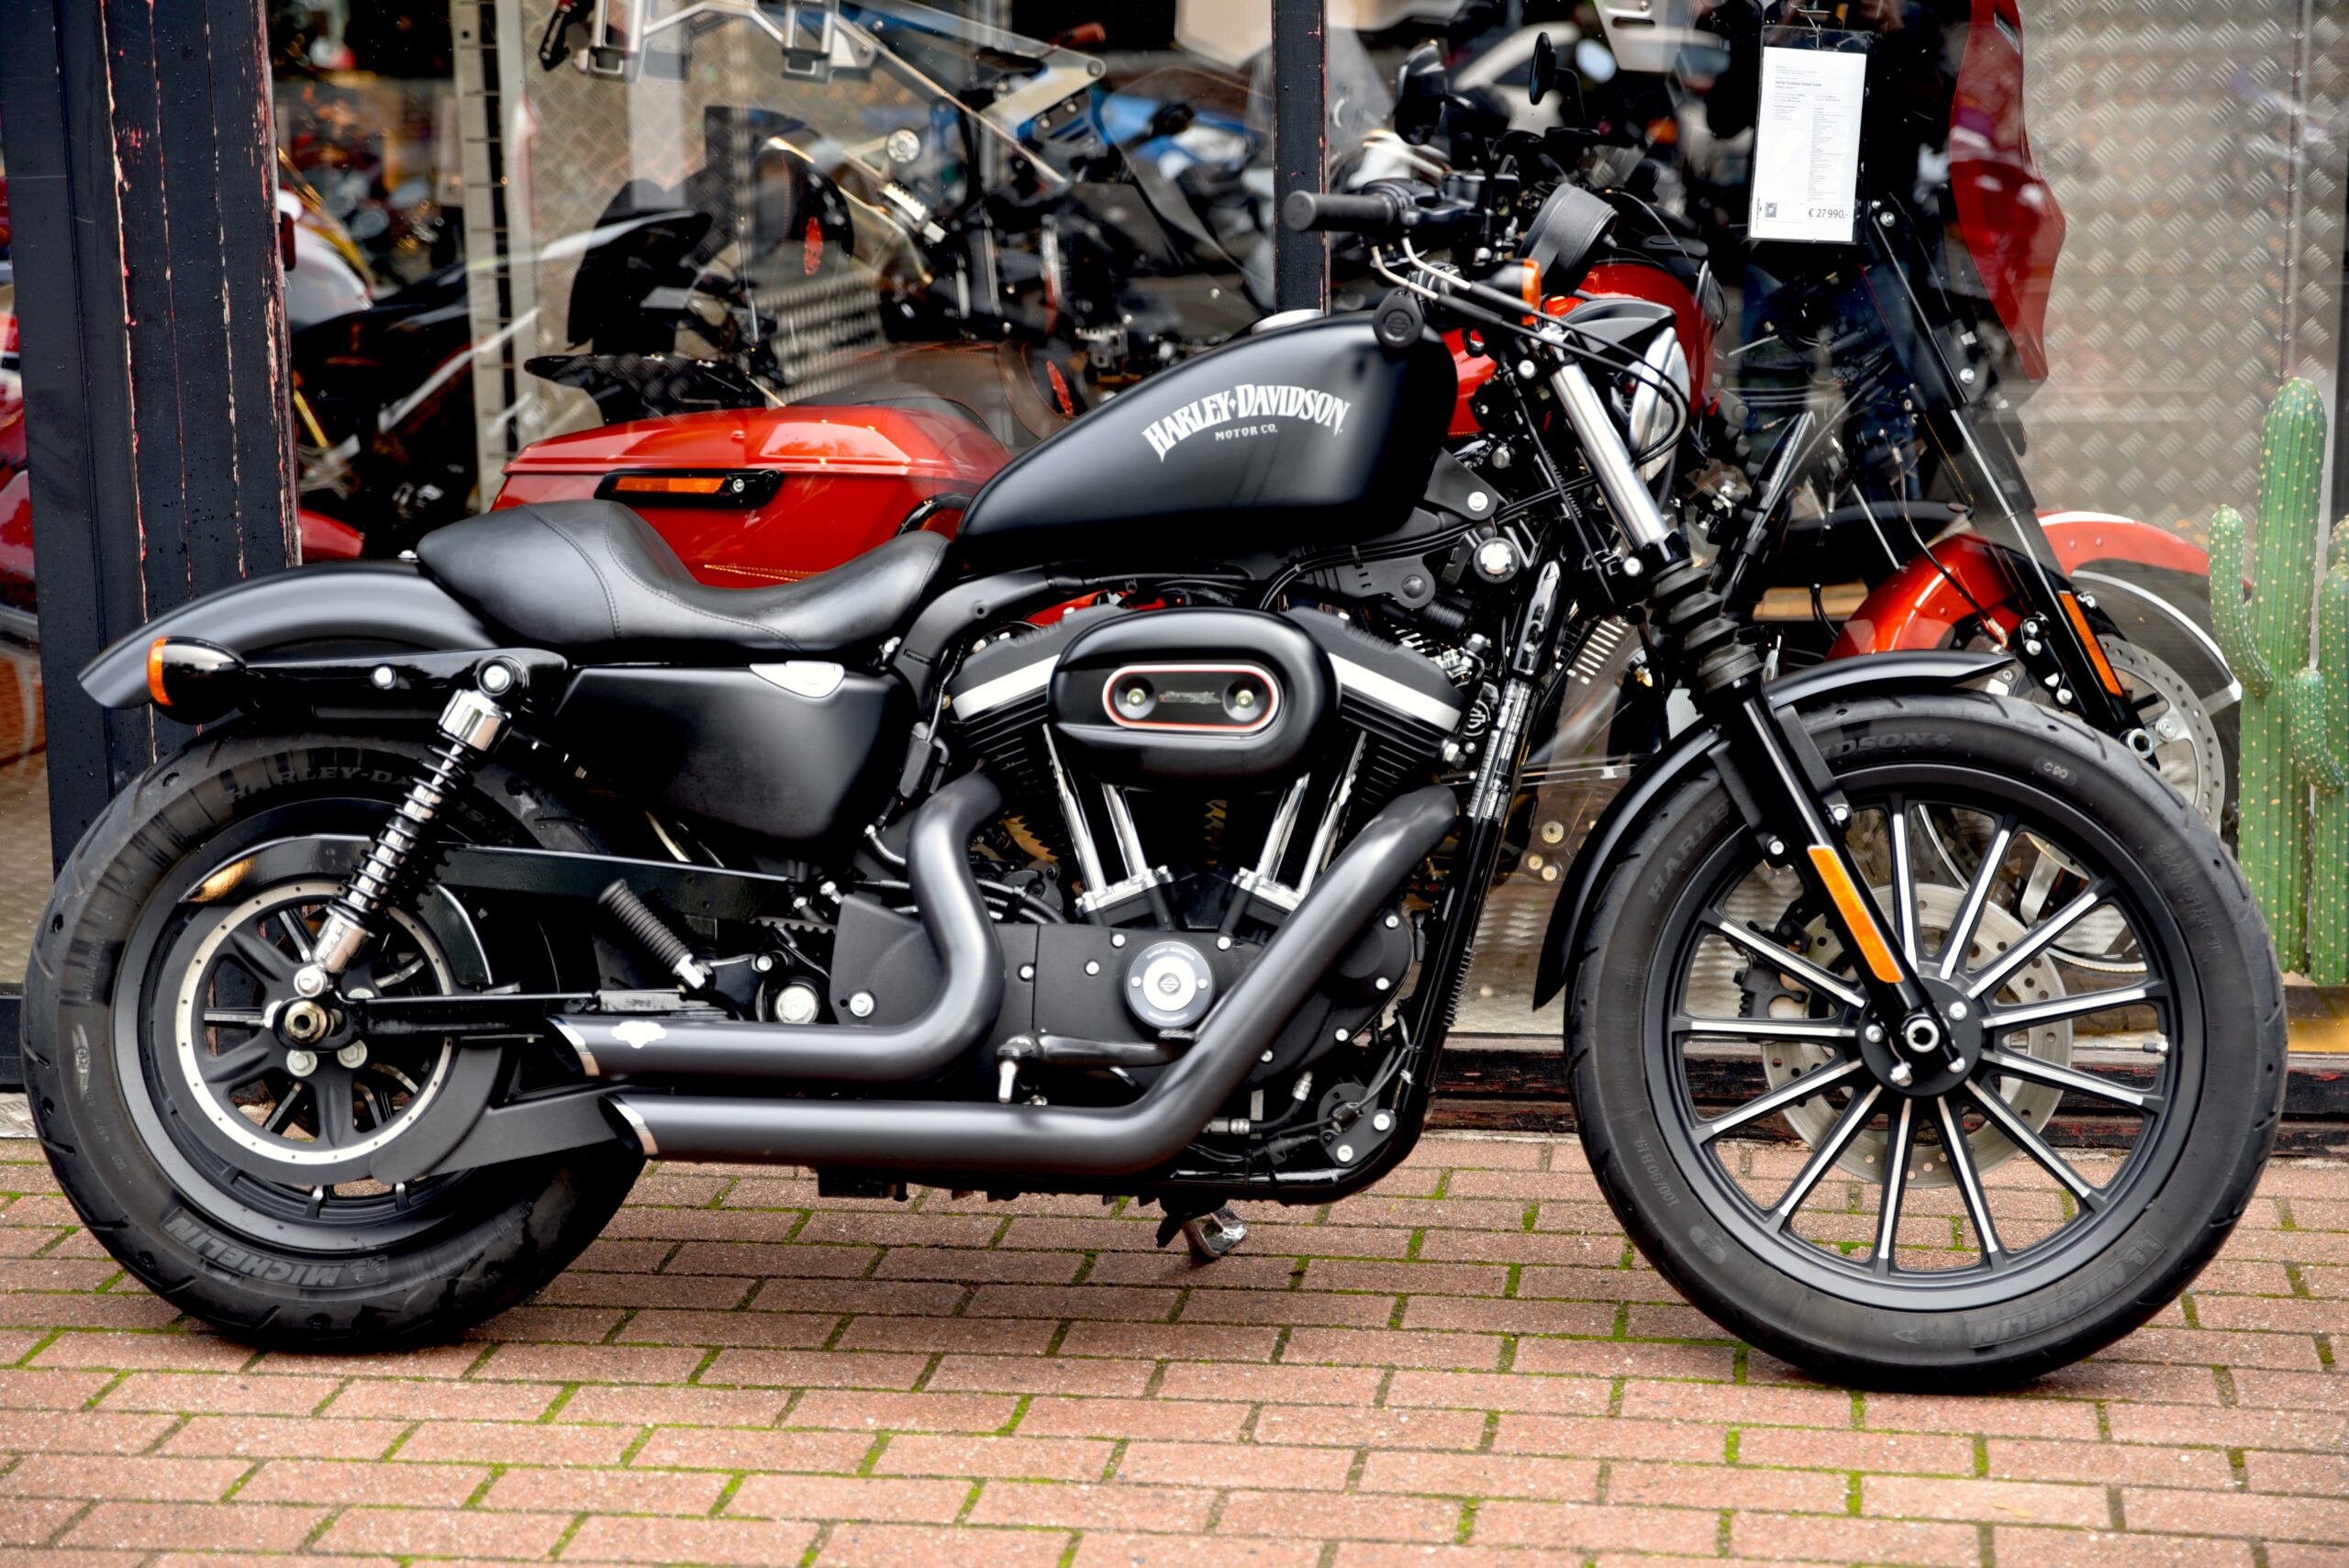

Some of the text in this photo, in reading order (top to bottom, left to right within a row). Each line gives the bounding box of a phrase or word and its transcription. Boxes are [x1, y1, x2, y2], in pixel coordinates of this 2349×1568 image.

[1809, 208, 1814, 217] €
[1215, 423, 1278, 441] MOTOR CO.
[162, 1216, 342, 1286] MICHELIN
[1970, 1264, 2128, 1346] MICHELIN
